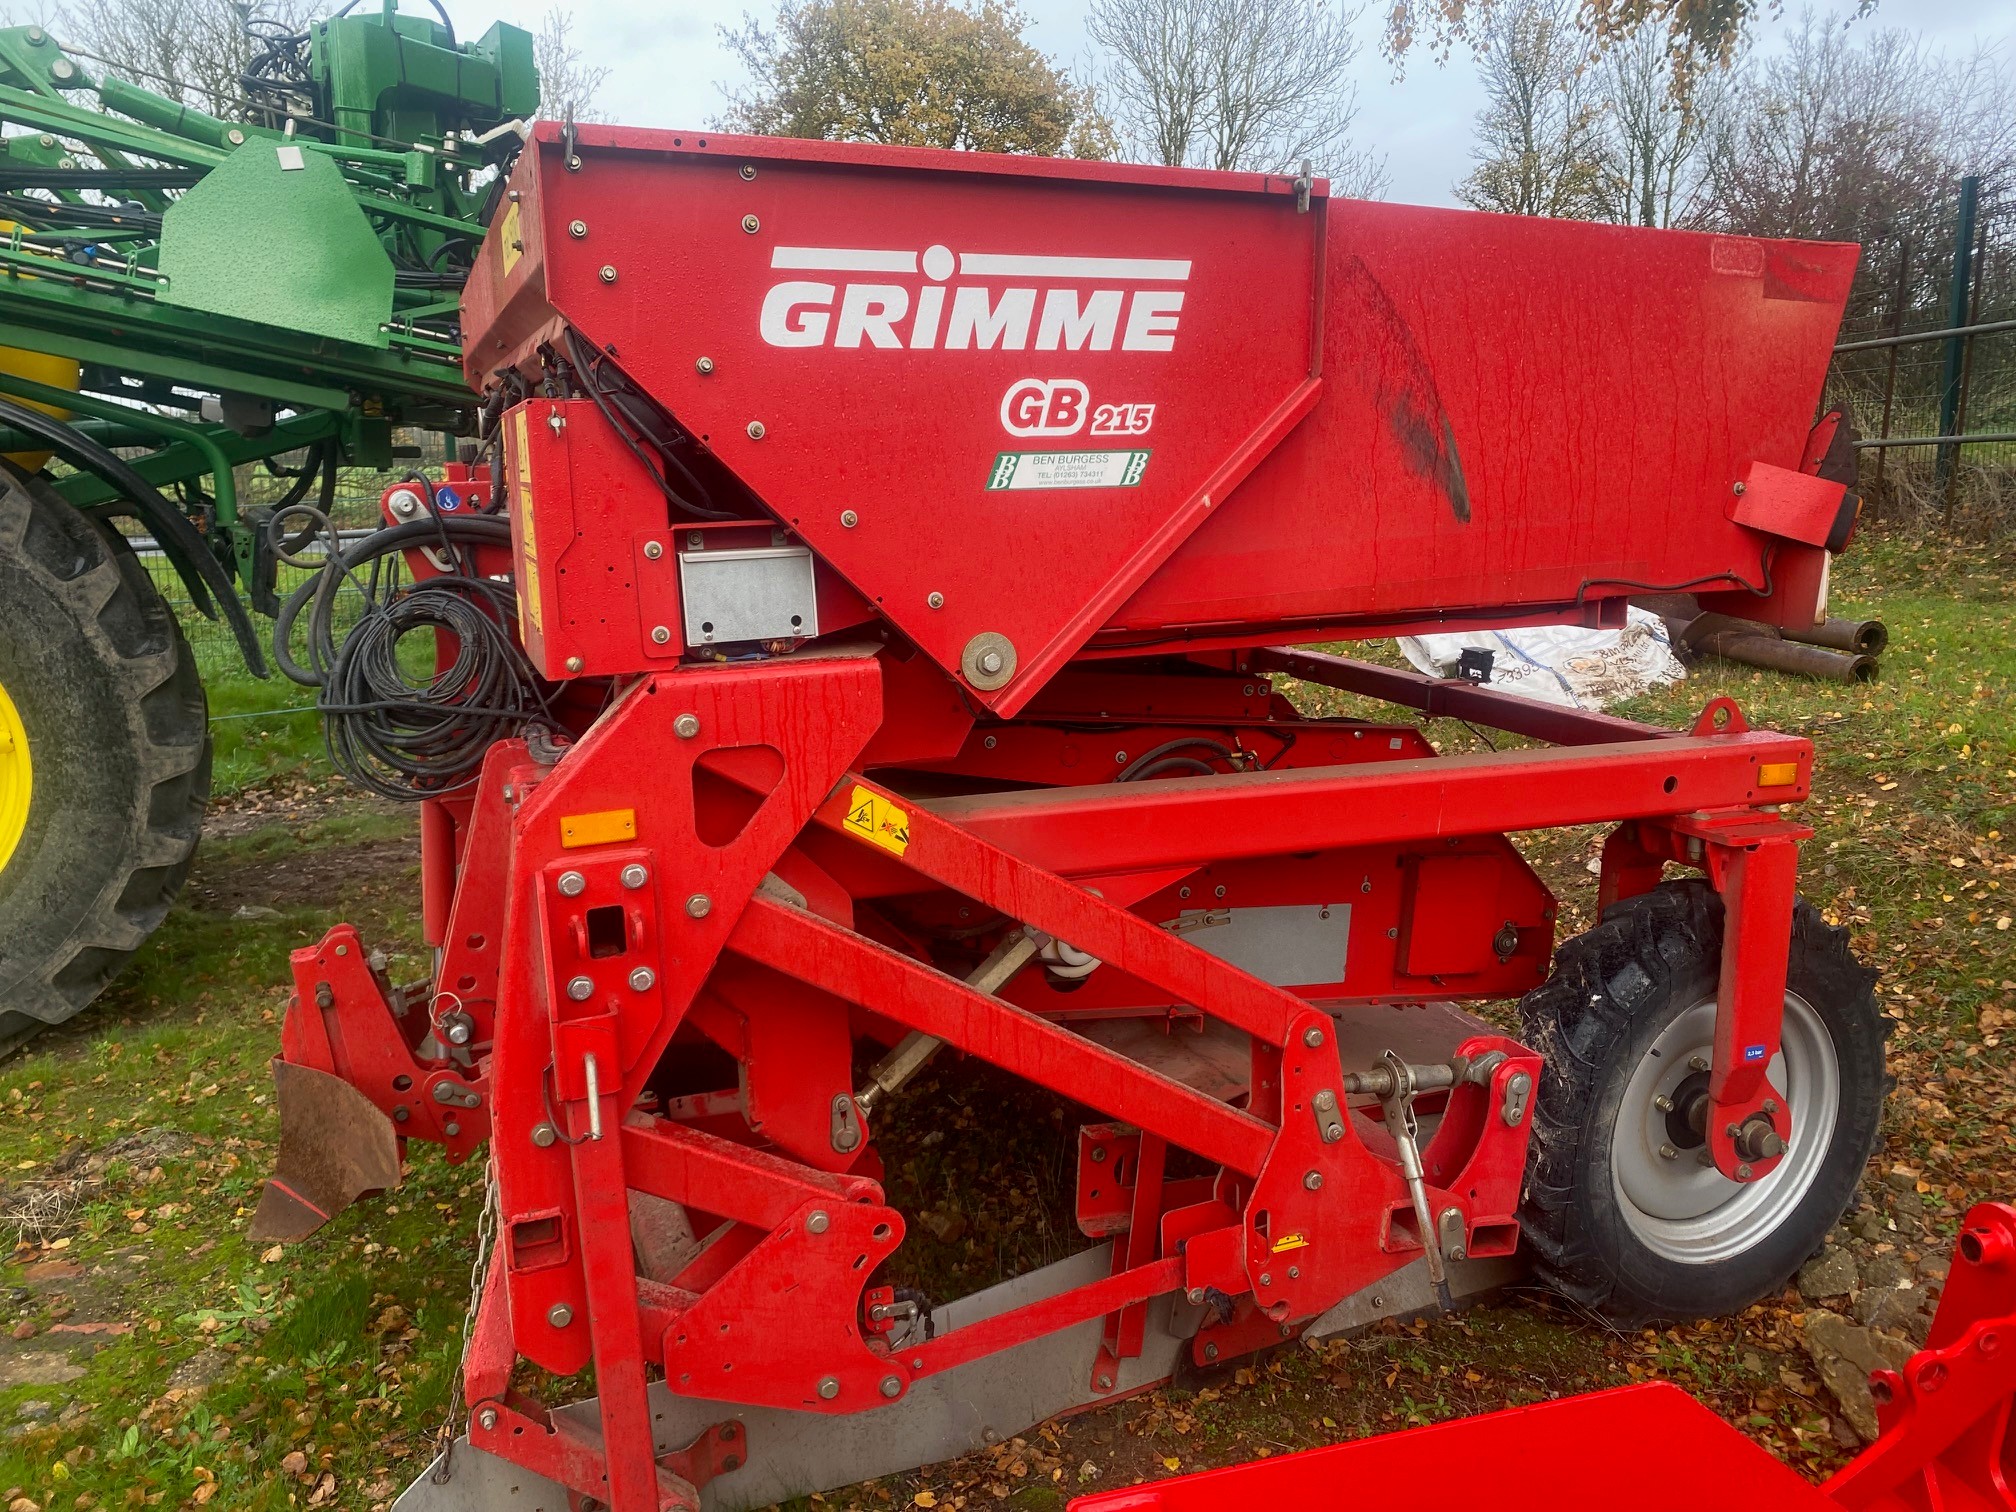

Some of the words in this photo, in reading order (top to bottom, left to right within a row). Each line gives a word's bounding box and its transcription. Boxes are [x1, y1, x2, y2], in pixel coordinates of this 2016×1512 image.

[759, 244, 1186, 353] GRIMME
[1000, 378, 1090, 437] GB
[1090, 403, 1156, 436] 215
[1033, 456, 1055, 465] BEN
[1058, 454, 1109, 464] BURGESS
[1054, 471, 1078, 479] (01263)
